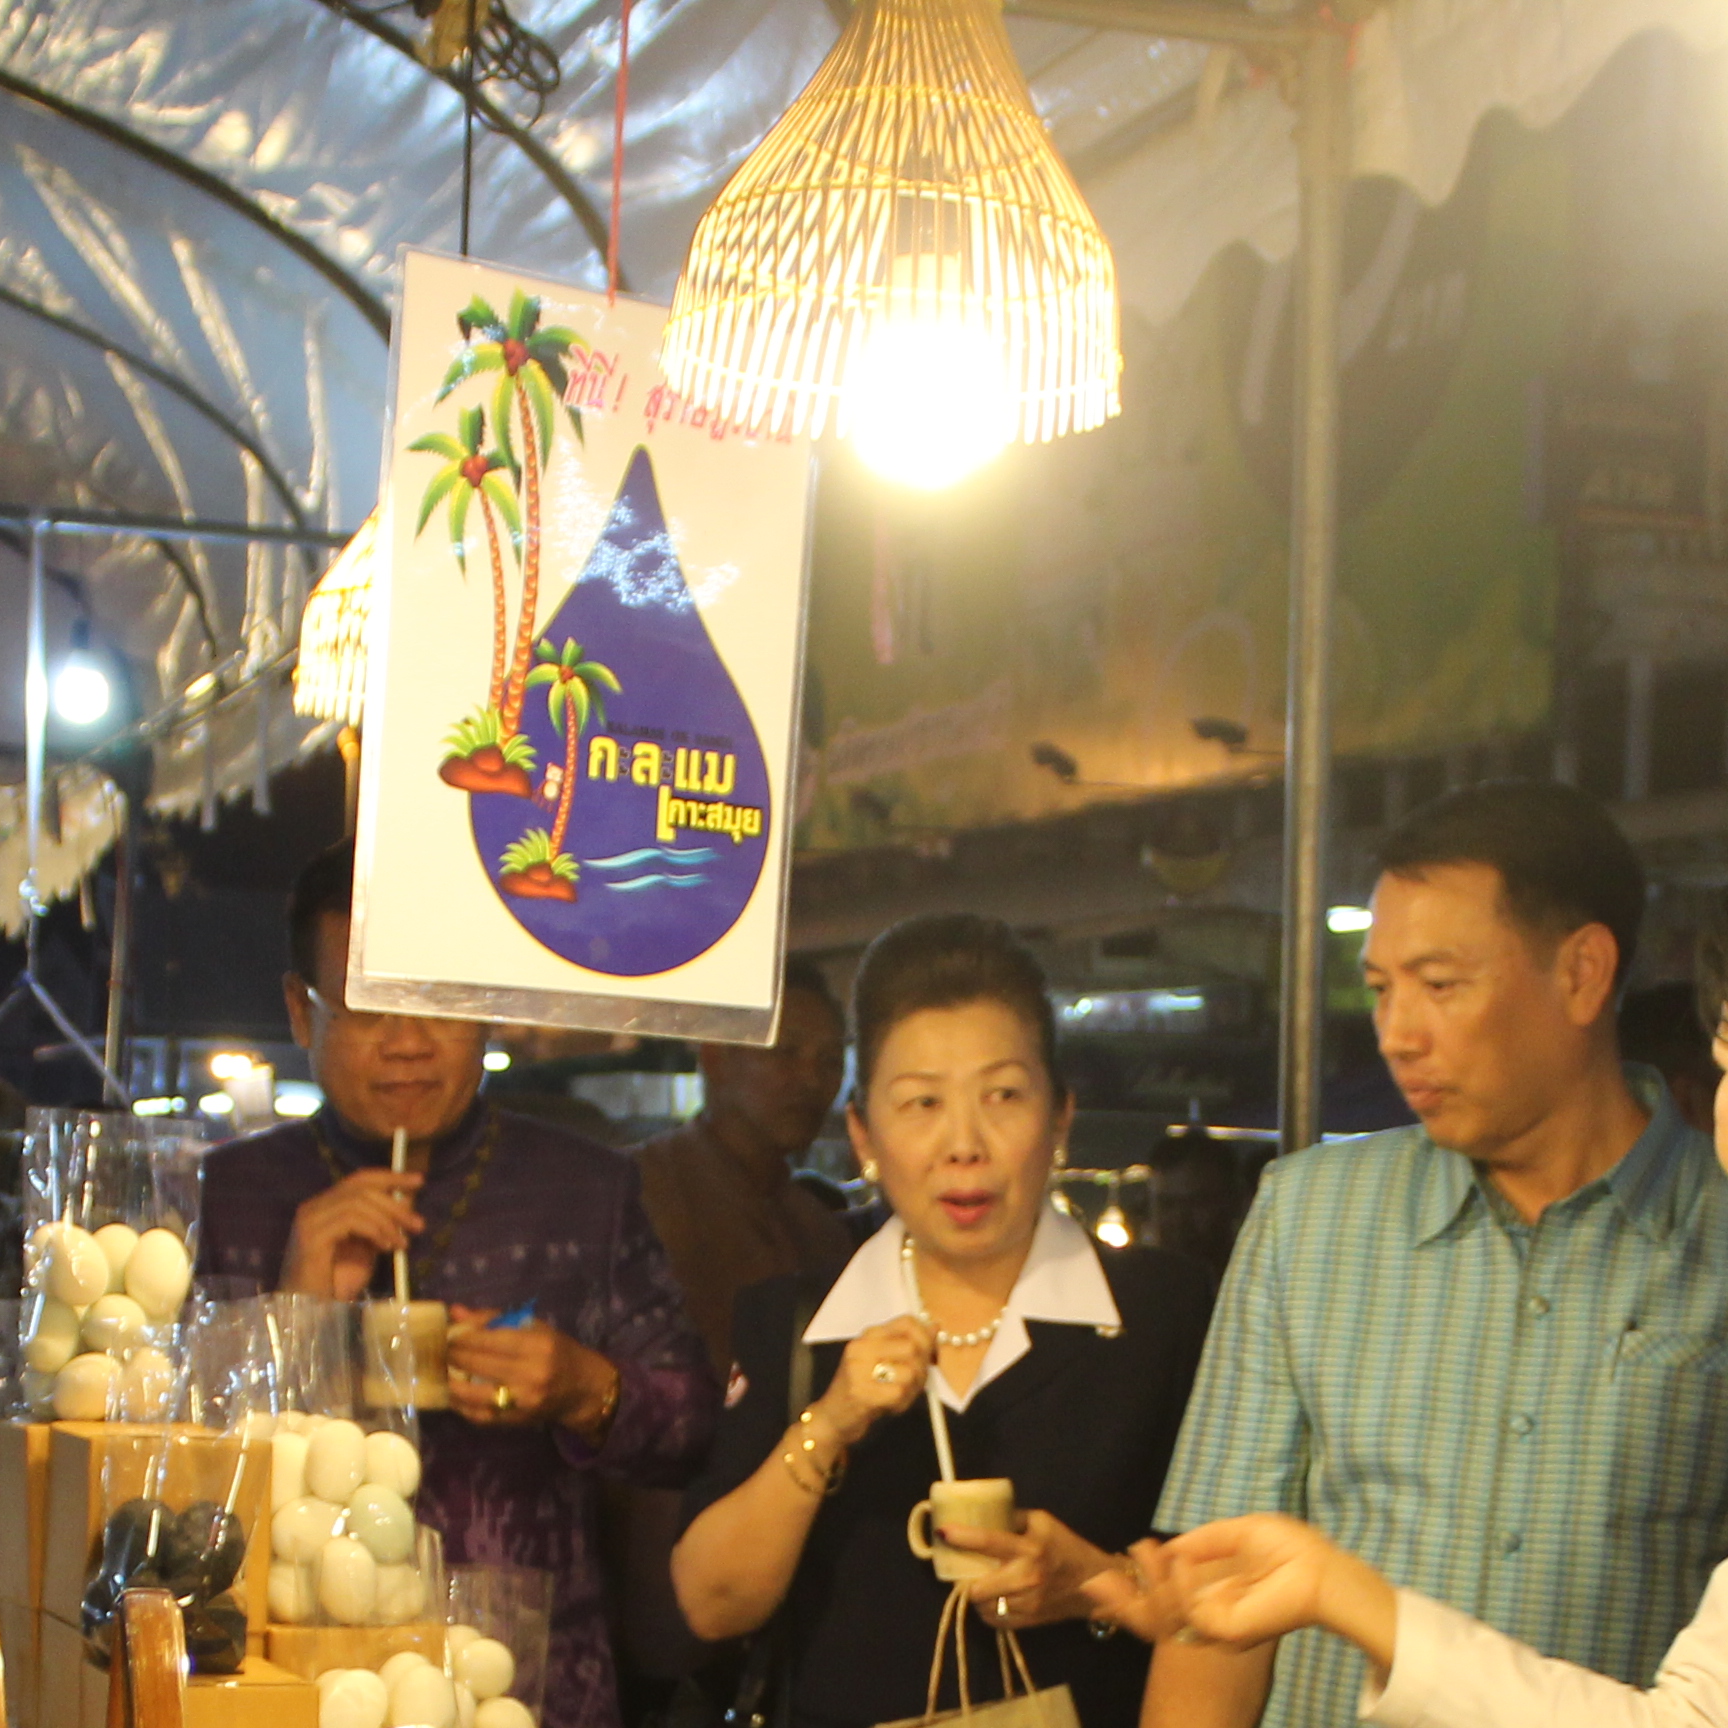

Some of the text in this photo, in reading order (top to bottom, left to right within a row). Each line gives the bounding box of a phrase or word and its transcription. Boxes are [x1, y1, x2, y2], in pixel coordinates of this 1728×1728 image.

[587, 735, 736, 796] กะละแม
[656, 785, 763, 844] เกาะสมุย
